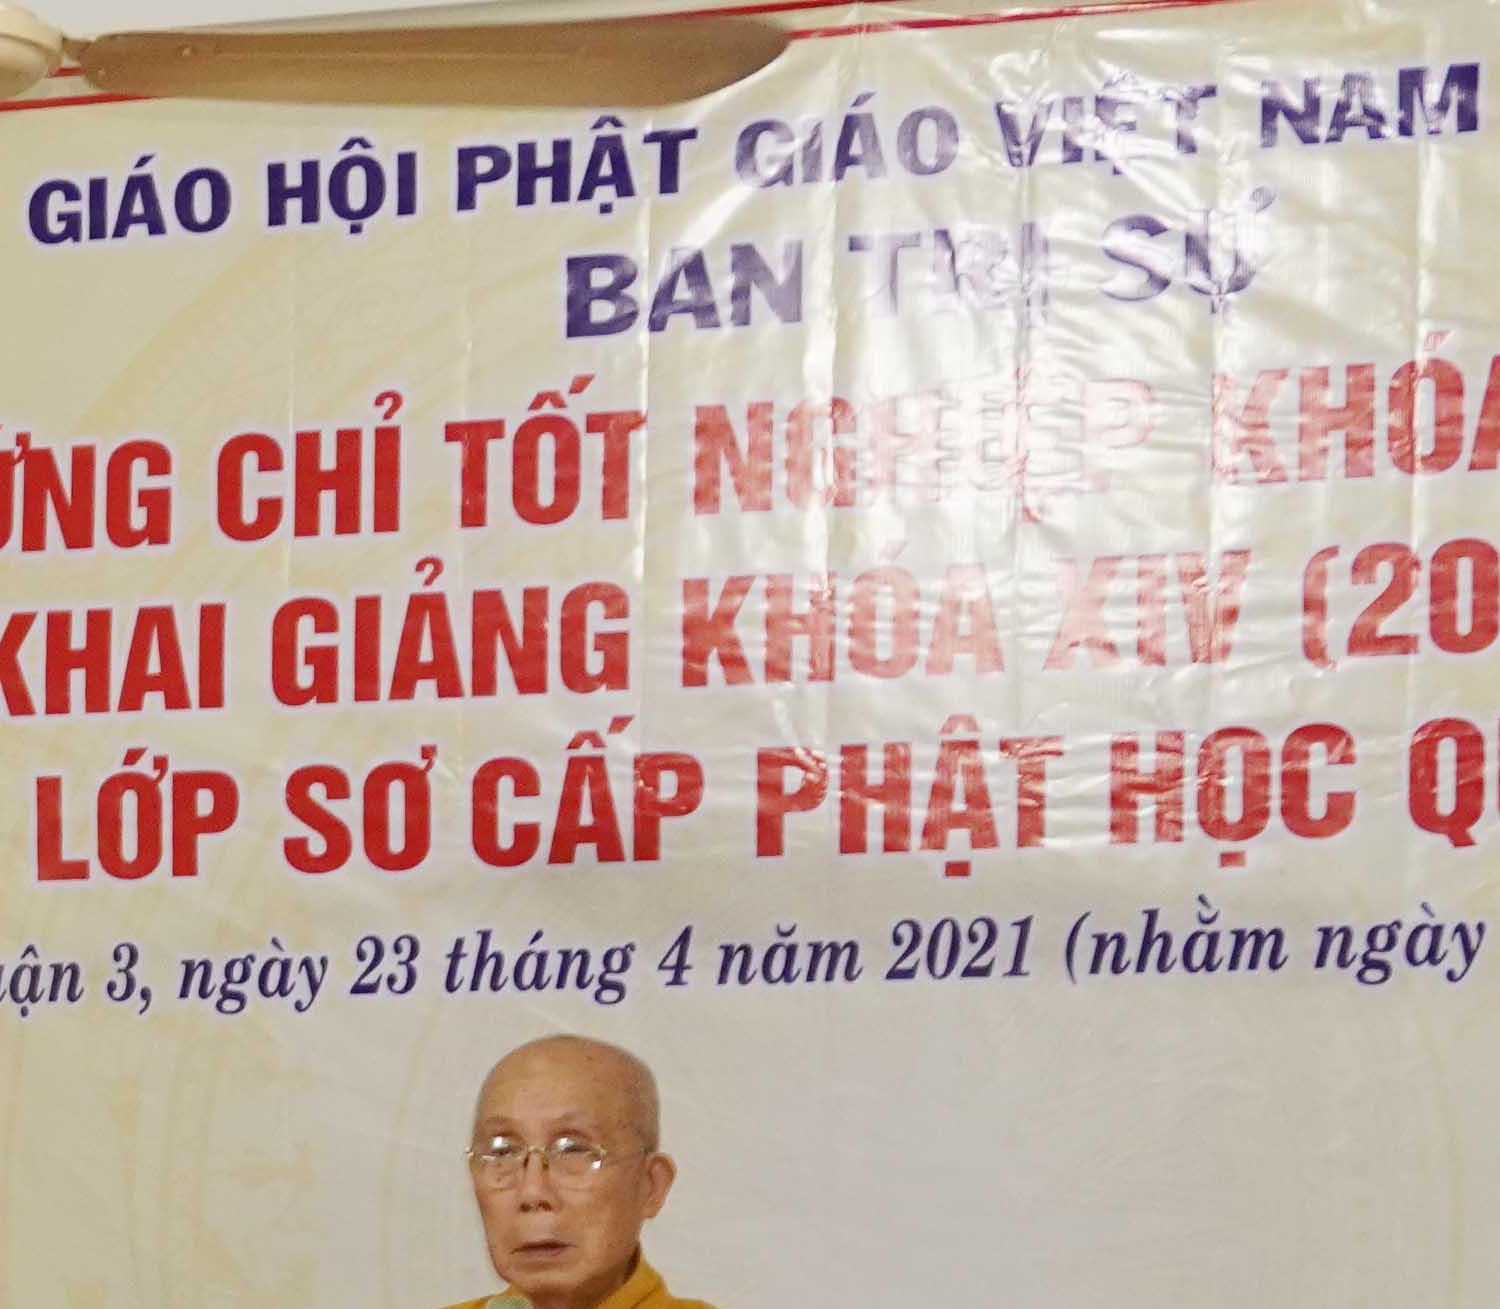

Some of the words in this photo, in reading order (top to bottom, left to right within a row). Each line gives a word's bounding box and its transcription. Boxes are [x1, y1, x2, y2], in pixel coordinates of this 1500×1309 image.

[28, 154, 231, 245] GIÁO
[265, 136, 418, 235] HỘI
[456, 114, 698, 215] PHẬT
[734, 90, 960, 188] GIÁO
[995, 72, 1217, 175] VIỆT
[1259, 62, 1480, 149] NAM
[565, 243, 801, 339] BAN
[1101, 185, 1276, 315] SỰ
[217, 390, 403, 542] CHỈ
[445, 374, 647, 529] TỐT
[272, 557, 630, 706] GIẢNG
[682, 542, 1005, 688] KHÓA
[1042, 550, 1250, 671] XIV
[36, 747, 240, 881] LỚP
[282, 744, 438, 874] SƠ
[472, 715, 702, 868] CẤP
[756, 715, 1064, 877] PHẬT
[1109, 723, 1356, 867] HỌC
[106, 941, 152, 1015] 3,
[179, 935, 328, 1017] ngày
[350, 933, 421, 997] 23
[445, 929, 637, 1005] tháng
[658, 925, 695, 988] 4
[717, 922, 863, 985] năm
[885, 915, 1035, 981] 2021
[1064, 895, 1288, 985] (nhằm
[1313, 903, 1486, 986] ngày
